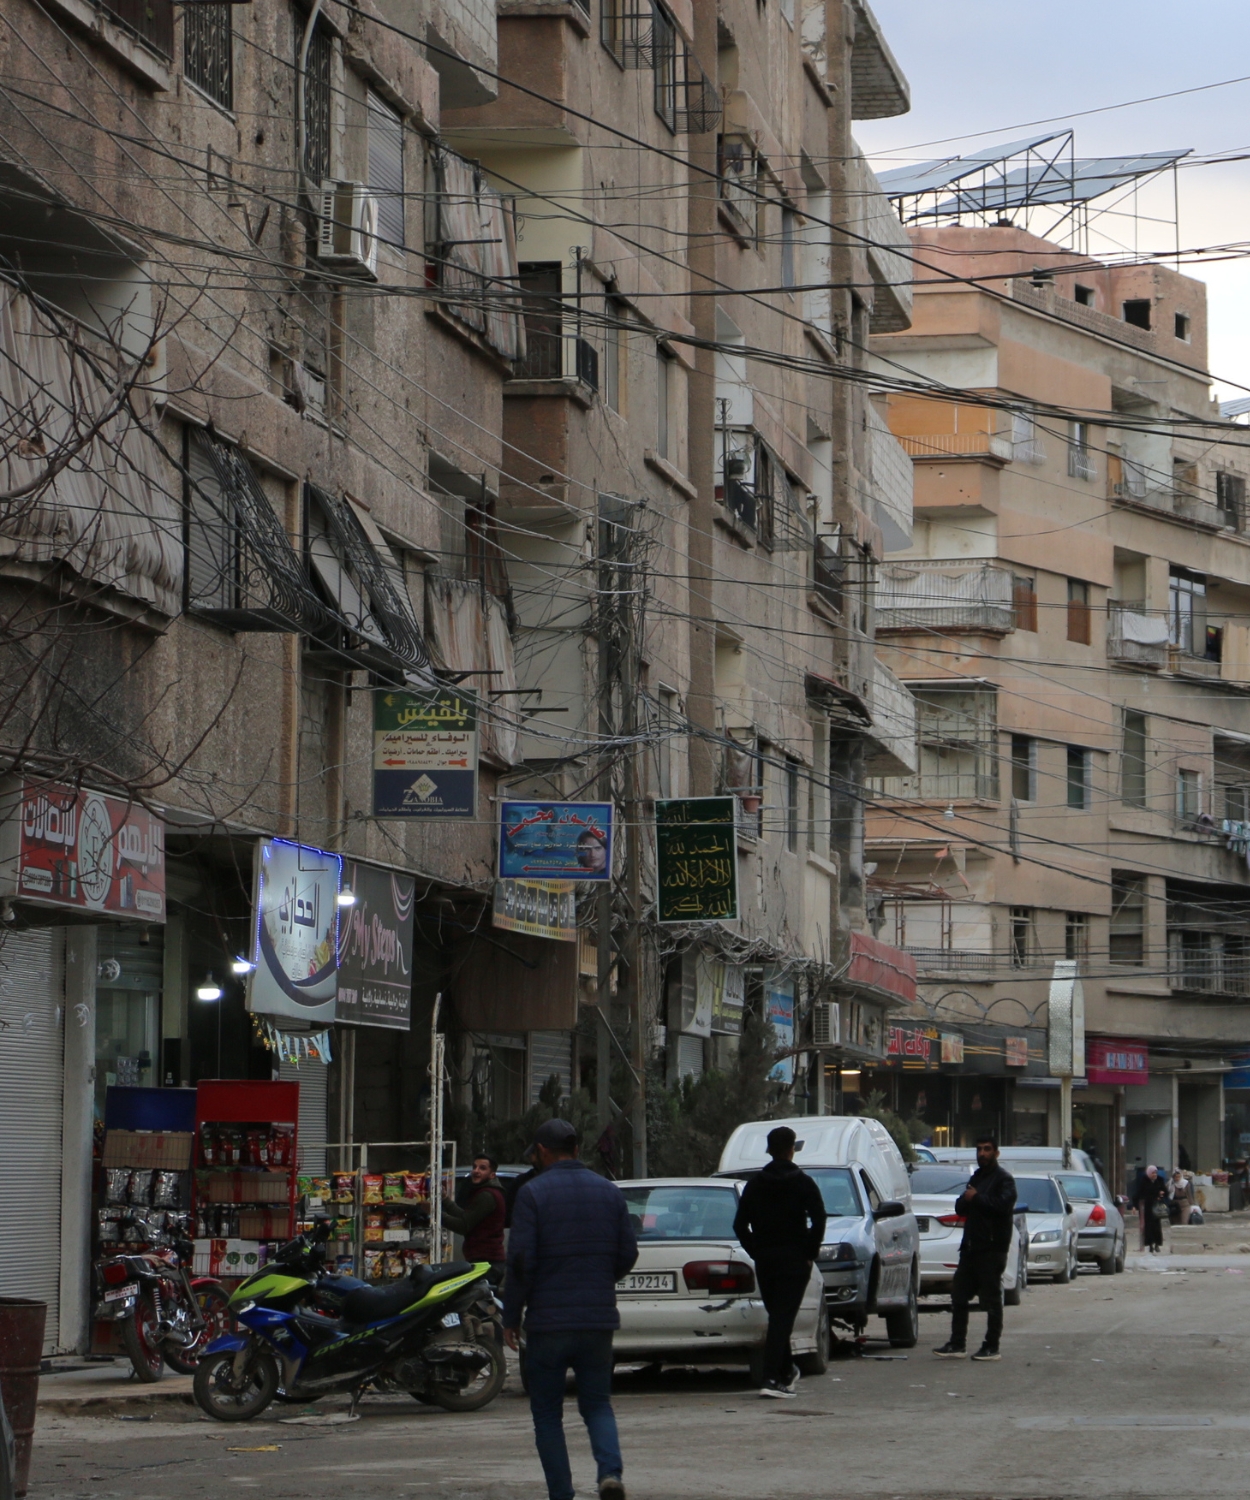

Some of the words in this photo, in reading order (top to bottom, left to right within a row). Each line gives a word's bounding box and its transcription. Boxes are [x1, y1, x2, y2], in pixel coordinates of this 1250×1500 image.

[397, 698, 468, 726] بلقيس
[382, 733, 428, 746] للسيراميك
[432, 732, 469, 744] الوفاء
[506, 810, 554, 837] محمد
[558, 808, 606, 839] صالون
[279, 876, 320, 940] الحجازي
[352, 901, 370, 970] My
[370, 913, 396, 975] Steps
[906, 1027, 931, 1063] بركات
[630, 1276, 668, 1288] 19214
